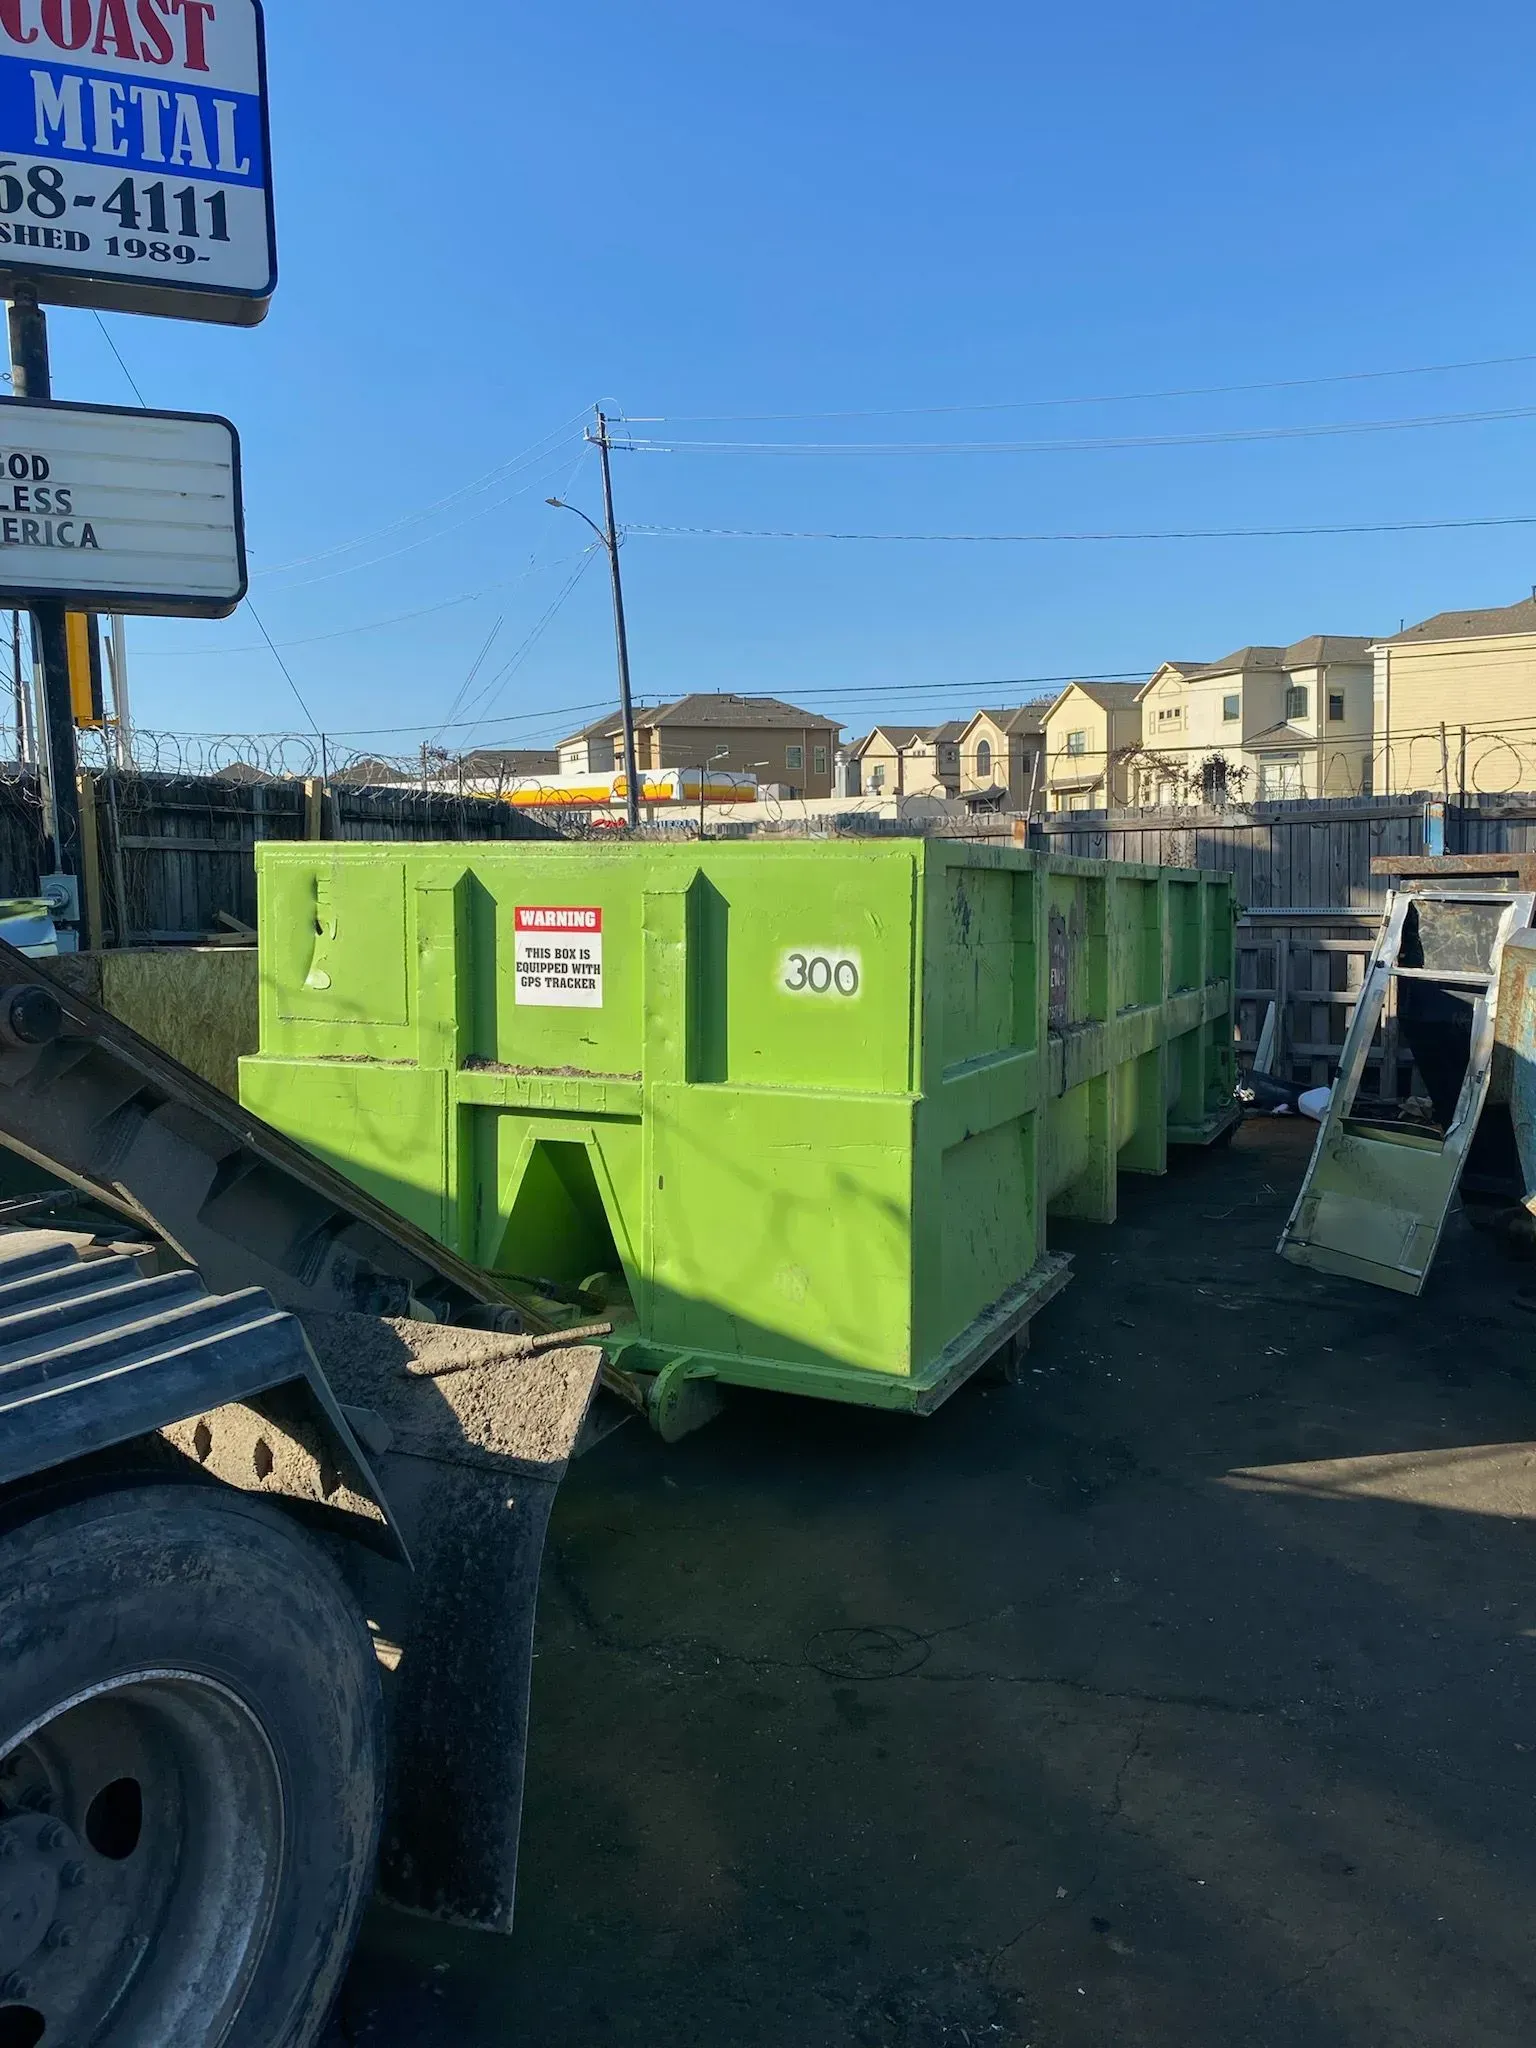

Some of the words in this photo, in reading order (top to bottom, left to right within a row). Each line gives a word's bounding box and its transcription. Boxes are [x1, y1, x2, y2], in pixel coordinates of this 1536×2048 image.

[0, 0, 215, 72] COAST
[30, 70, 250, 175] METAL
[104, 236, 211, 264] 1989-
[0, 452, 49, 481] OD
[2, 517, 99, 549] ERICA
[520, 910, 596, 928] WARNING
[525, 947, 551, 959] THIS
[555, 948, 576, 960] BOX
[580, 949, 590, 960] IS
[516, 962, 568, 974] EQUIPPED
[572, 963, 601, 975] WITH
[521, 976, 541, 988] GPS
[545, 977, 596, 989] TRACKER
[785, 953, 859, 996] 300
